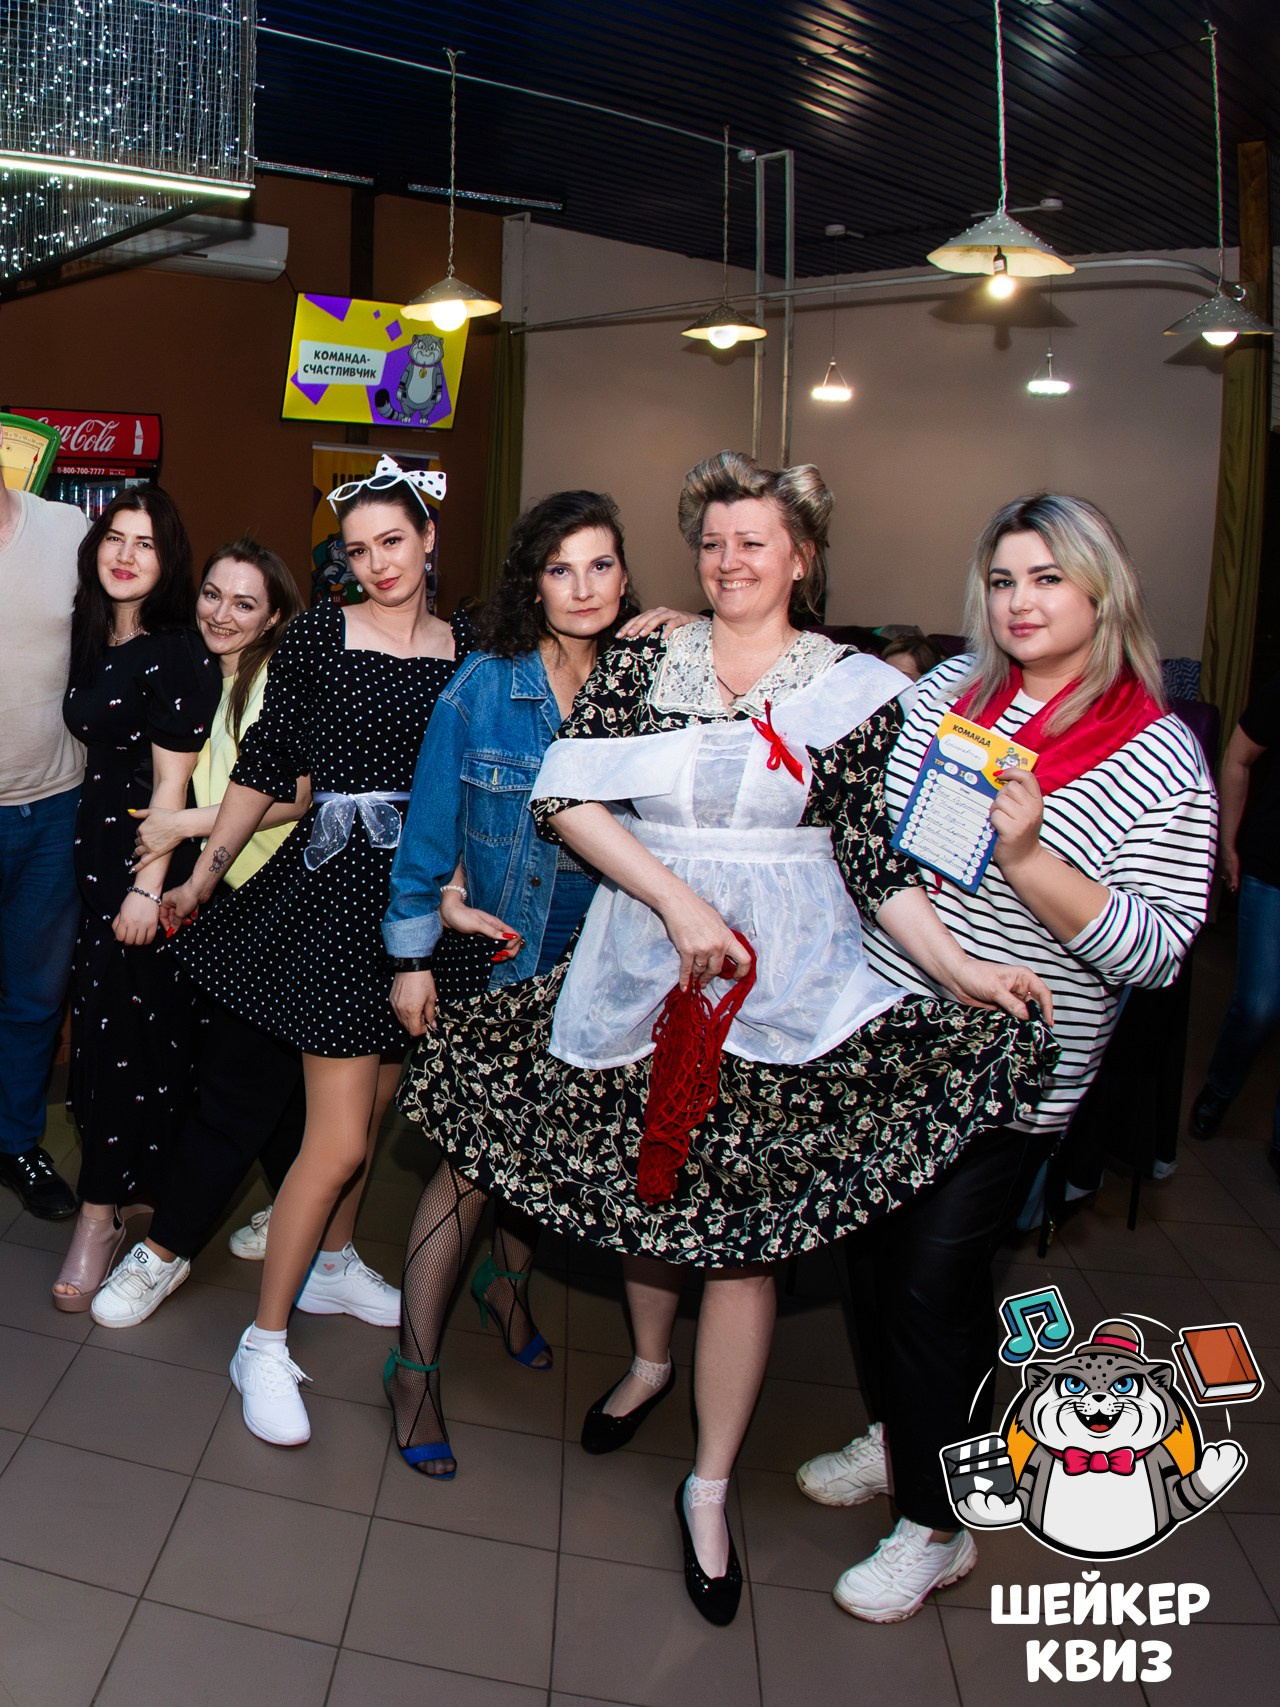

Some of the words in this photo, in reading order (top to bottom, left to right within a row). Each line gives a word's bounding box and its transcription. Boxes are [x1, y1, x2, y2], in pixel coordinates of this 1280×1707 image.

[313, 349, 370, 364] КОМАНДА-
[303, 364, 377, 379] СЧАСТЛИВЧИК
[952, 724, 991, 748] КОМАНДА
